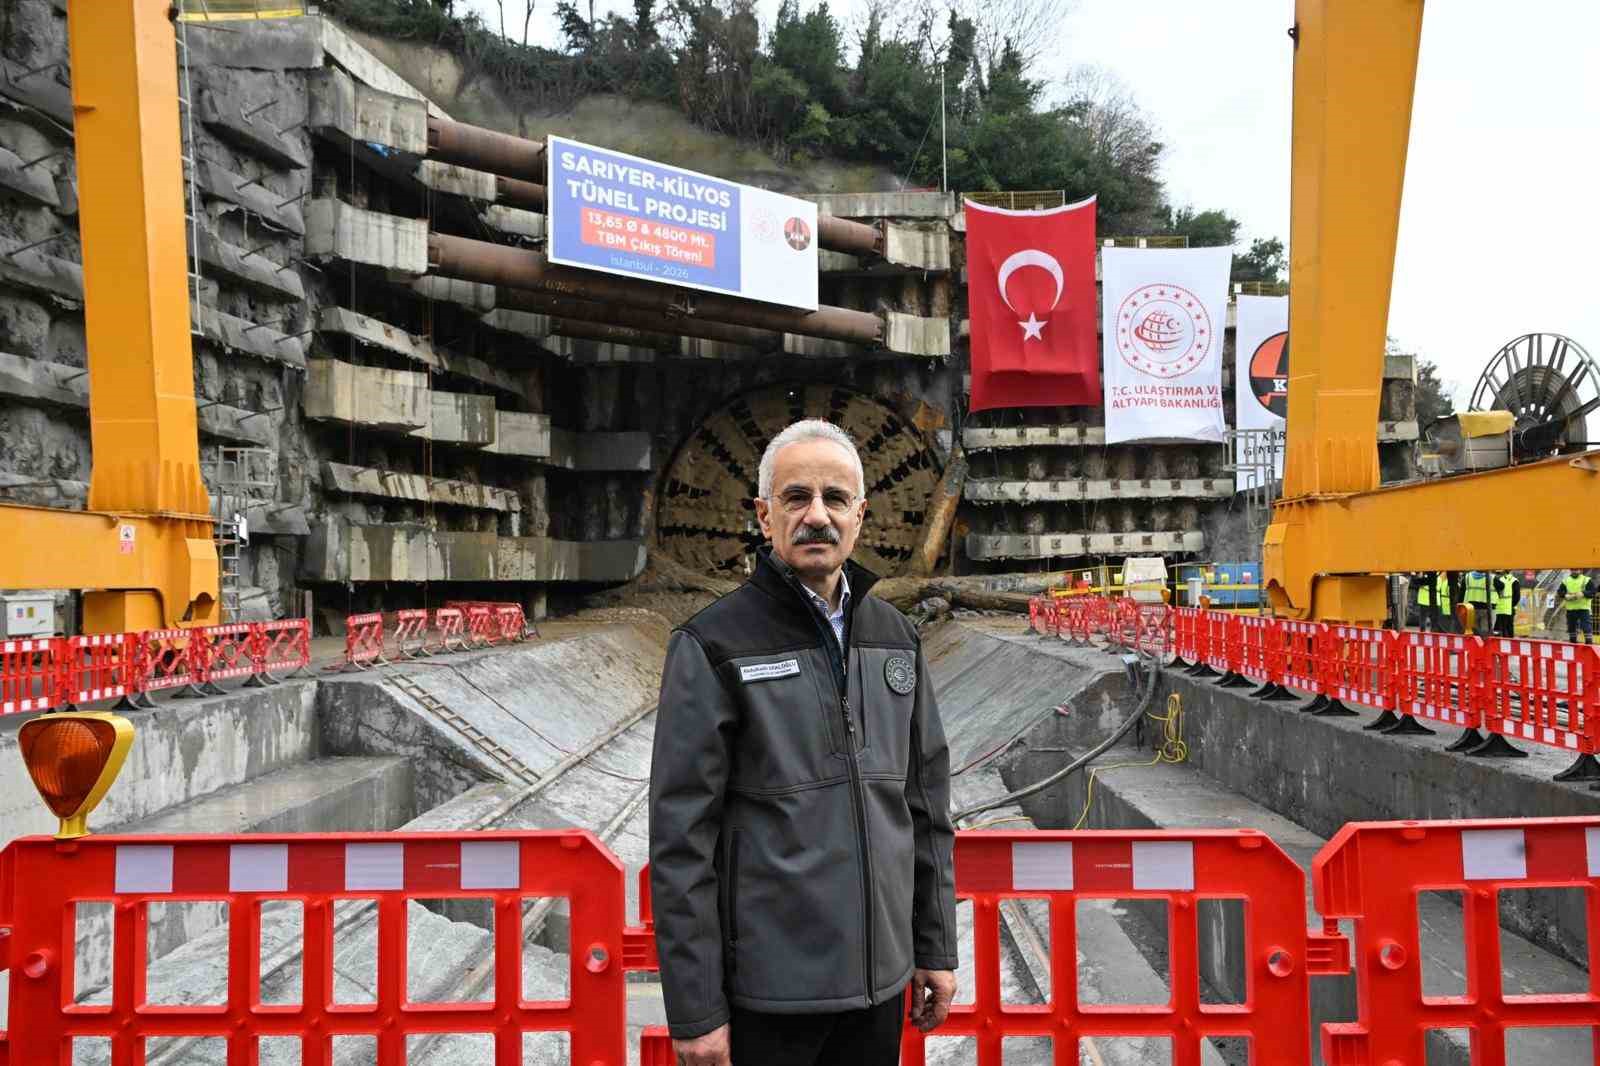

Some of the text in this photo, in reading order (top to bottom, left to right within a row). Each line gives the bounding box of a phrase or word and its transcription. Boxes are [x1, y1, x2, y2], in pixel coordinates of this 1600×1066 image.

[561, 152, 731, 208] SARIYER-KİLYOS
[566, 179, 727, 232] TÜNEL PROJESİ
[588, 211, 623, 229] 13,65
[653, 226, 688, 243] 4800
[597, 230, 626, 247] TBM
[664, 243, 704, 264] Töreni
[1112, 386, 1131, 396] T.C.
[1112, 398, 1158, 409] ALTYAPI
